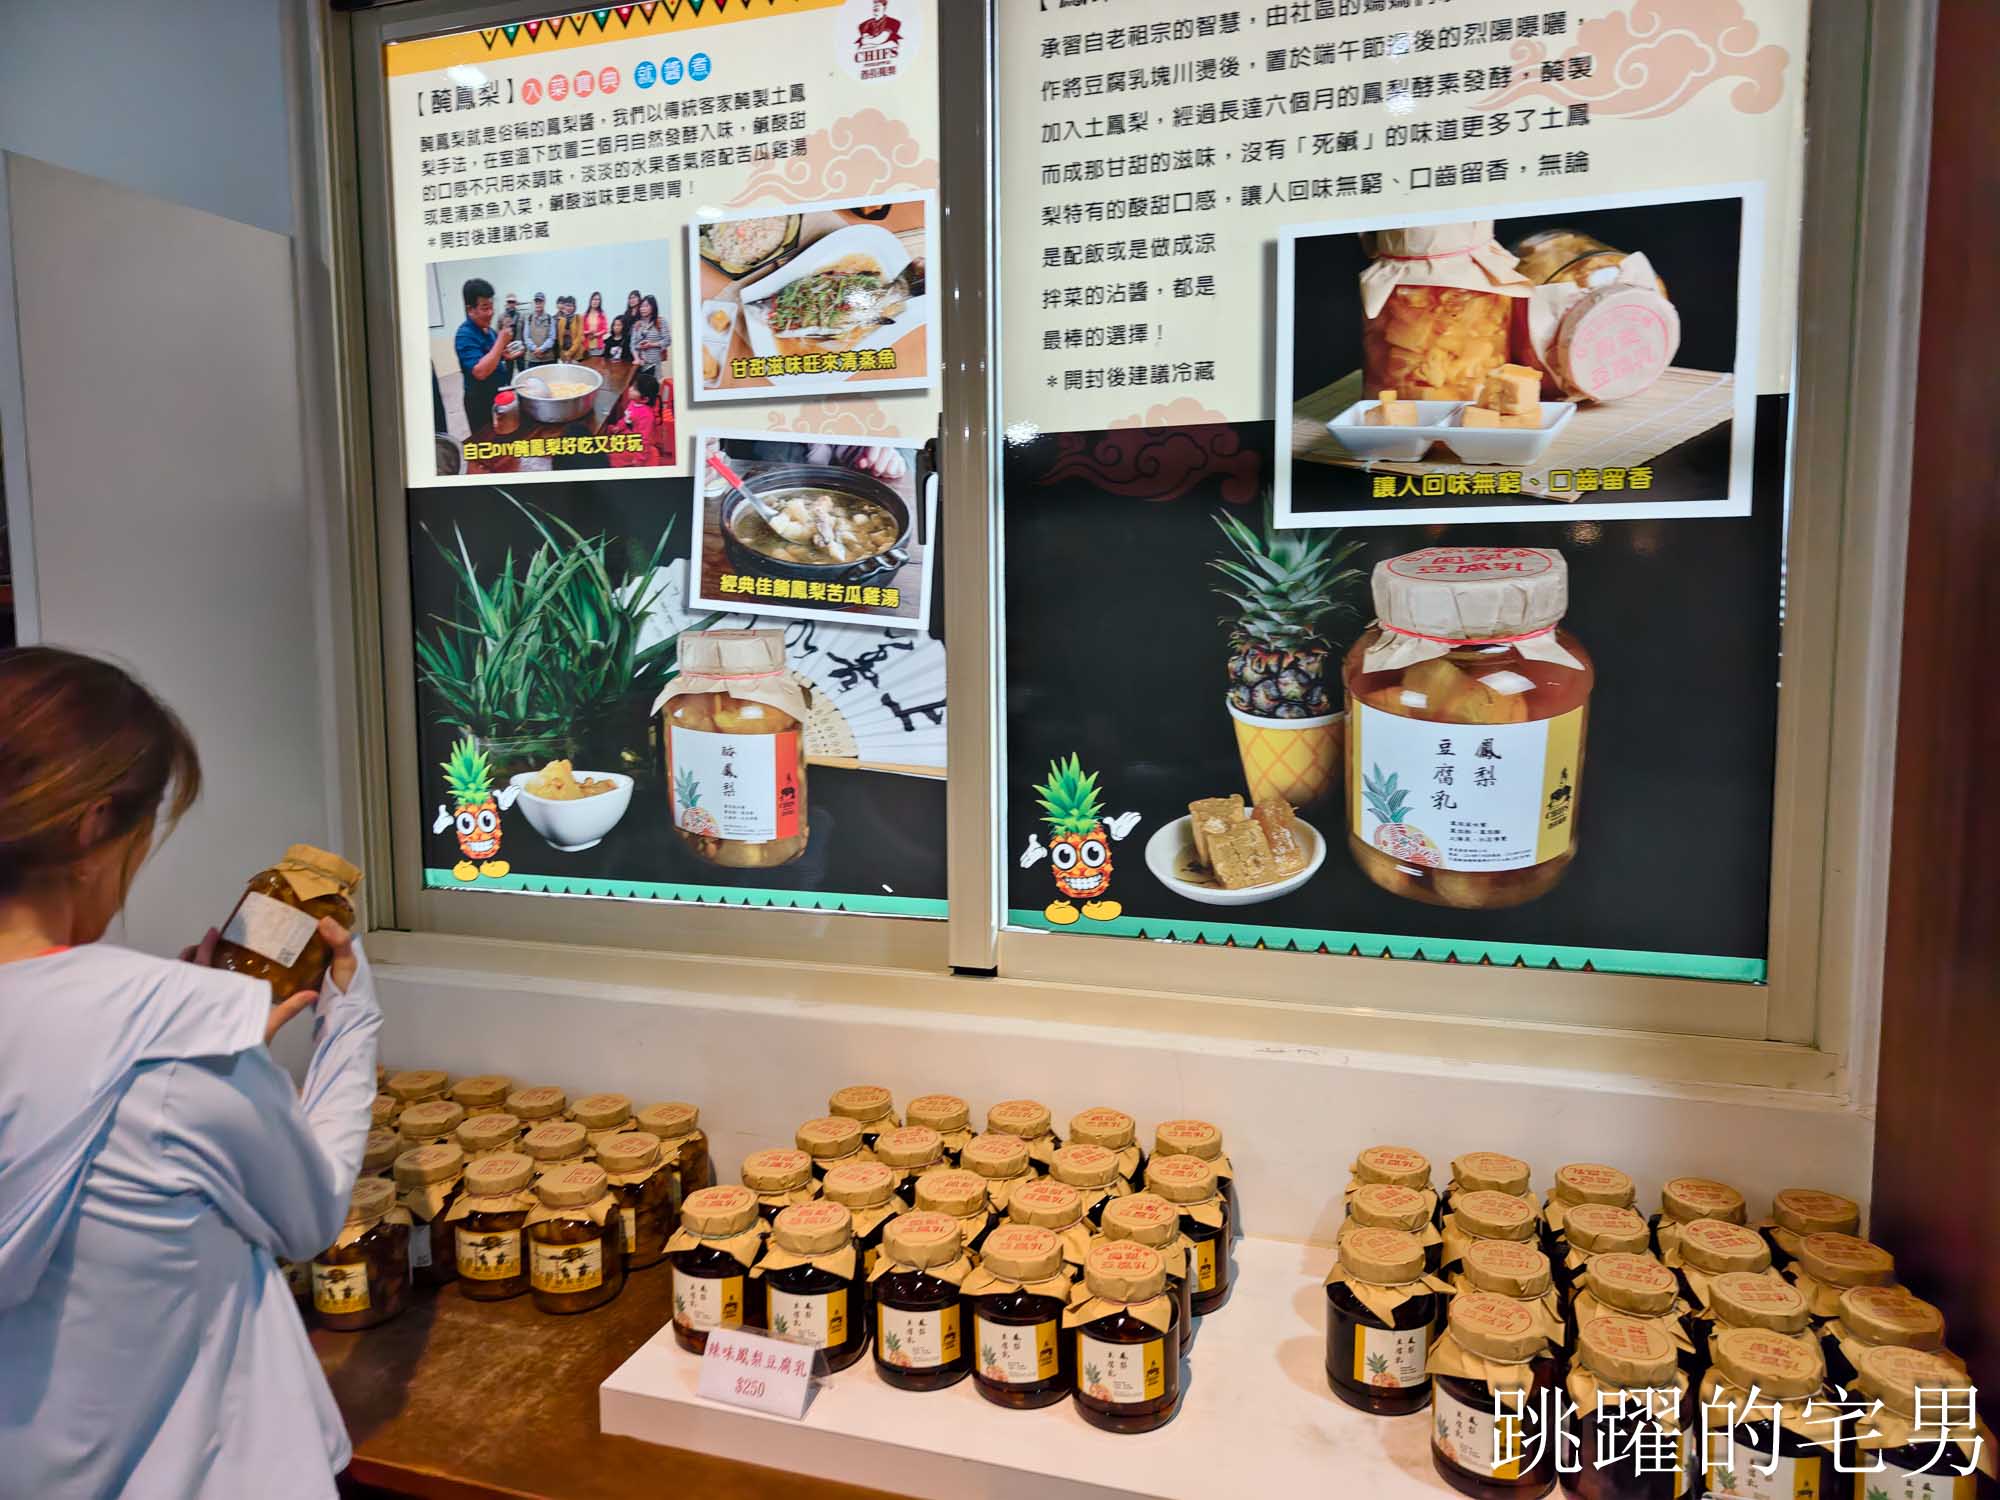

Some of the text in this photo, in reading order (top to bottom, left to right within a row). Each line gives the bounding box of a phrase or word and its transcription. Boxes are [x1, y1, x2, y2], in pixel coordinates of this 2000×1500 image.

[854, 48, 899, 63] CHIFS
[1041, 232, 1217, 268] 是配飯或是做成涼
[1041, 275, 1217, 310] 拌菜的沾醬，都是
[1042, 322, 1163, 350] 最棒的選擇！
[731, 348, 897, 379] 甘甜滋味旺來清蒸魚
[1431, 738, 1458, 811] 豆腐乳
[1474, 737, 1502, 787] 鳳梨
[735, 1376, 766, 1399] $250
